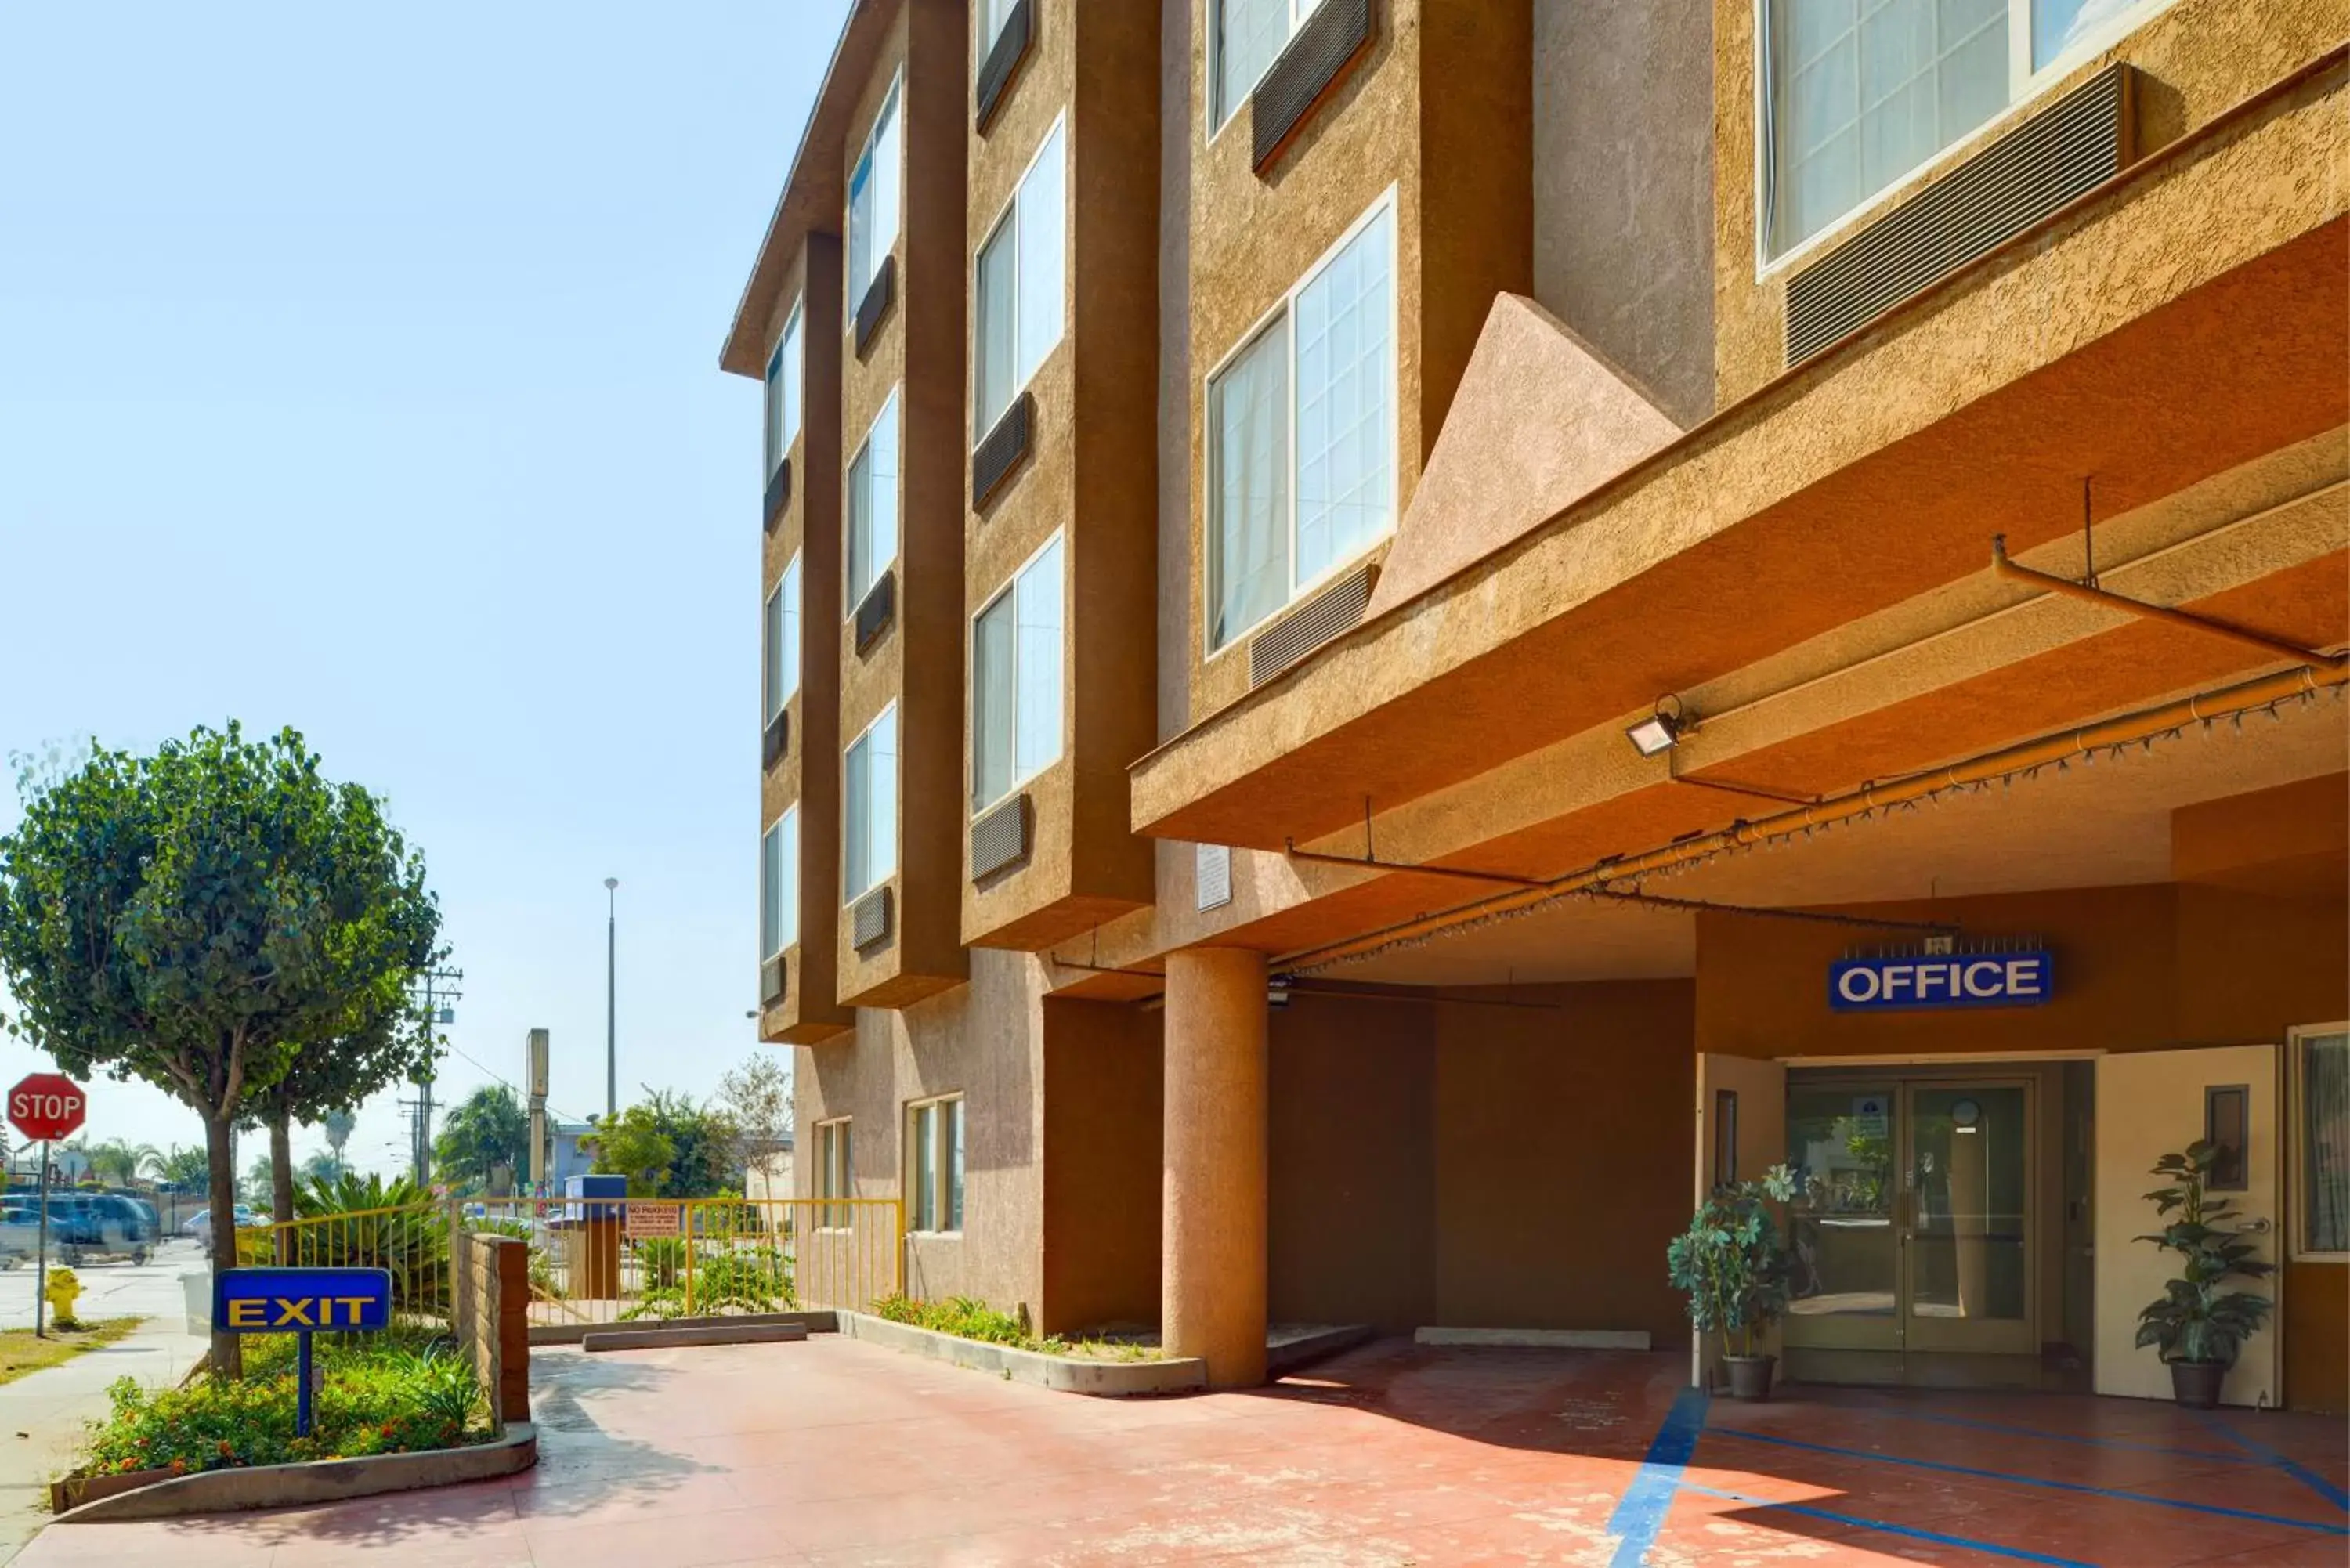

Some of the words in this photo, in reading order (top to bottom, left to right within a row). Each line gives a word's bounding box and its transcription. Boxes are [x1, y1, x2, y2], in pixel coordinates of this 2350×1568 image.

[1838, 960, 2041, 1002] OFFICE
[13, 1093, 81, 1120] STOP
[229, 1296, 376, 1327] EXIT
